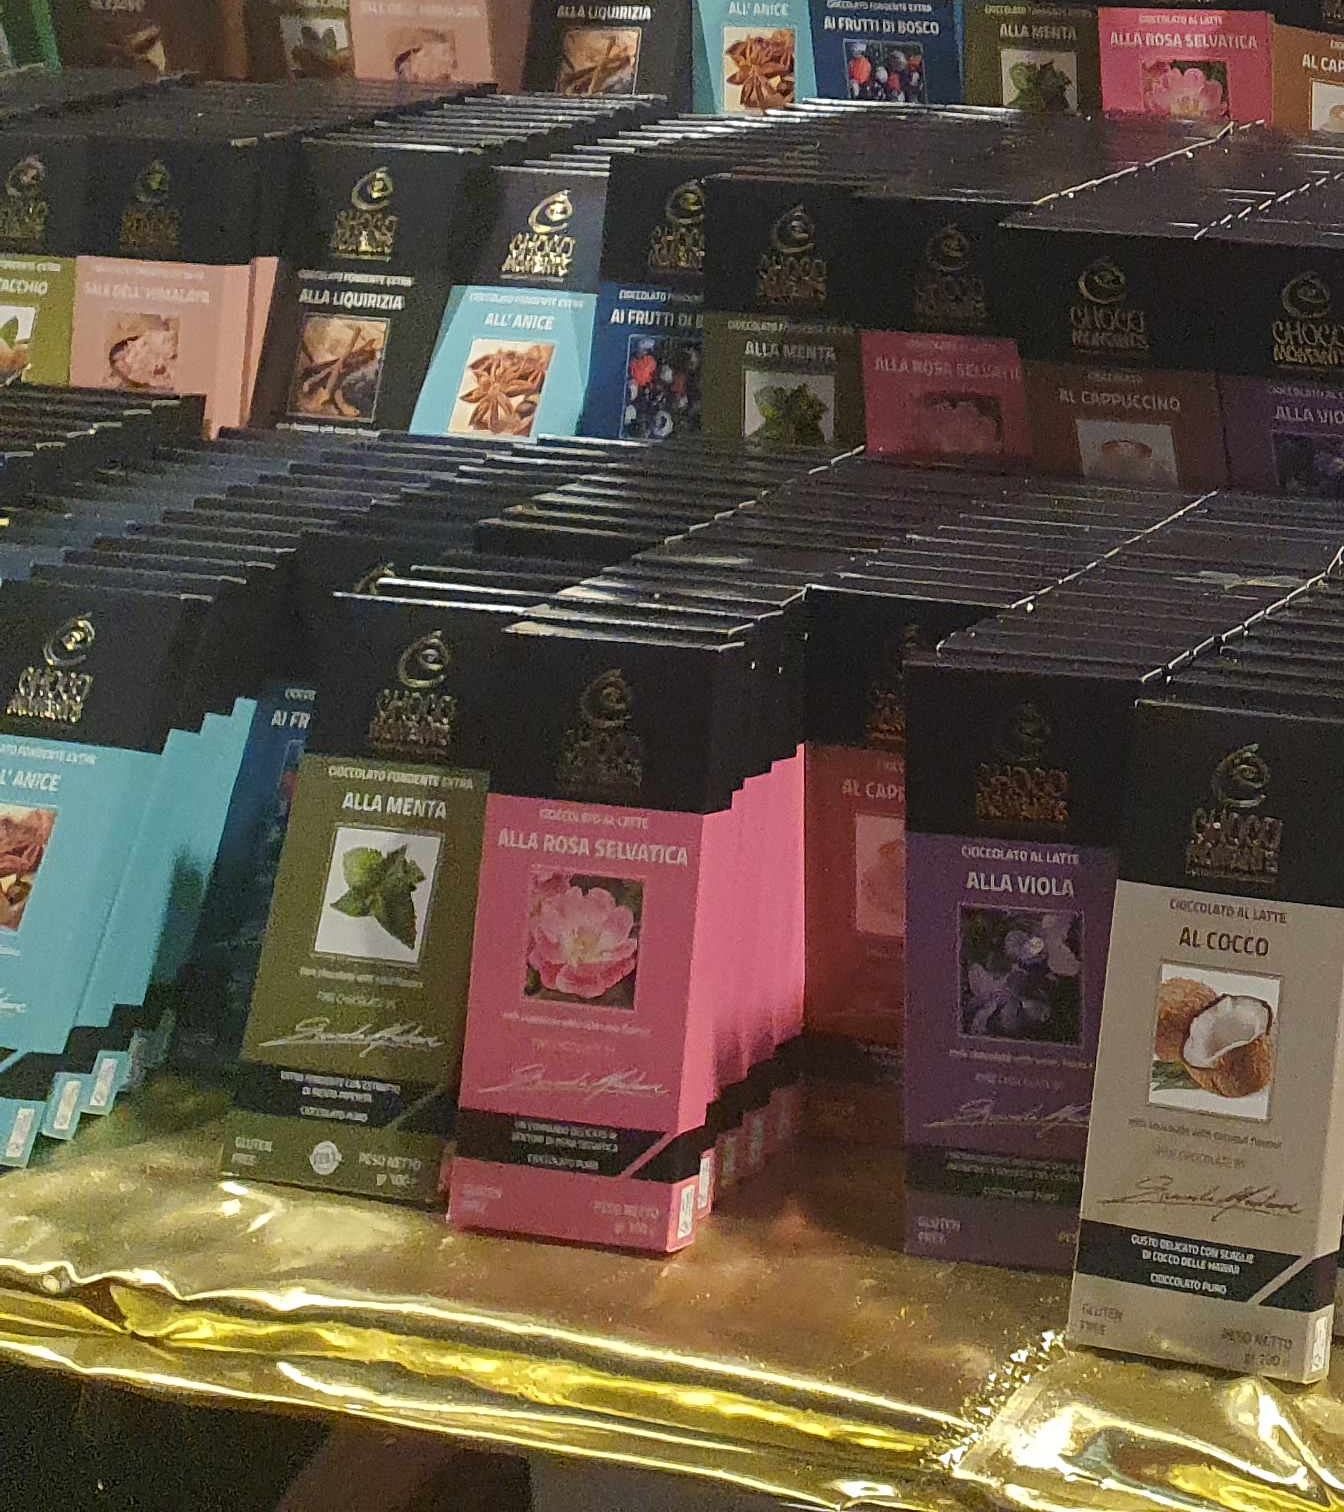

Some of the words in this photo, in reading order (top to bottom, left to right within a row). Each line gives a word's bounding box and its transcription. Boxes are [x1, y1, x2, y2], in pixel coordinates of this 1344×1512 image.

[299, 290, 330, 305] ALLA
[334, 292, 404, 309] LIQUIRIZIA
[513, 314, 555, 331] ANICE
[342, 792, 382, 813] ALLA
[387, 797, 446, 819] MENTA
[499, 828, 539, 851] ALLA
[544, 833, 589, 857] ROSA
[595, 839, 687, 866] SELVATICA
[967, 872, 1013, 892] ALLA
[1018, 875, 1074, 897] VIOLA
[1179, 927, 1201, 947] AL
[1207, 932, 1269, 956] COCCO
